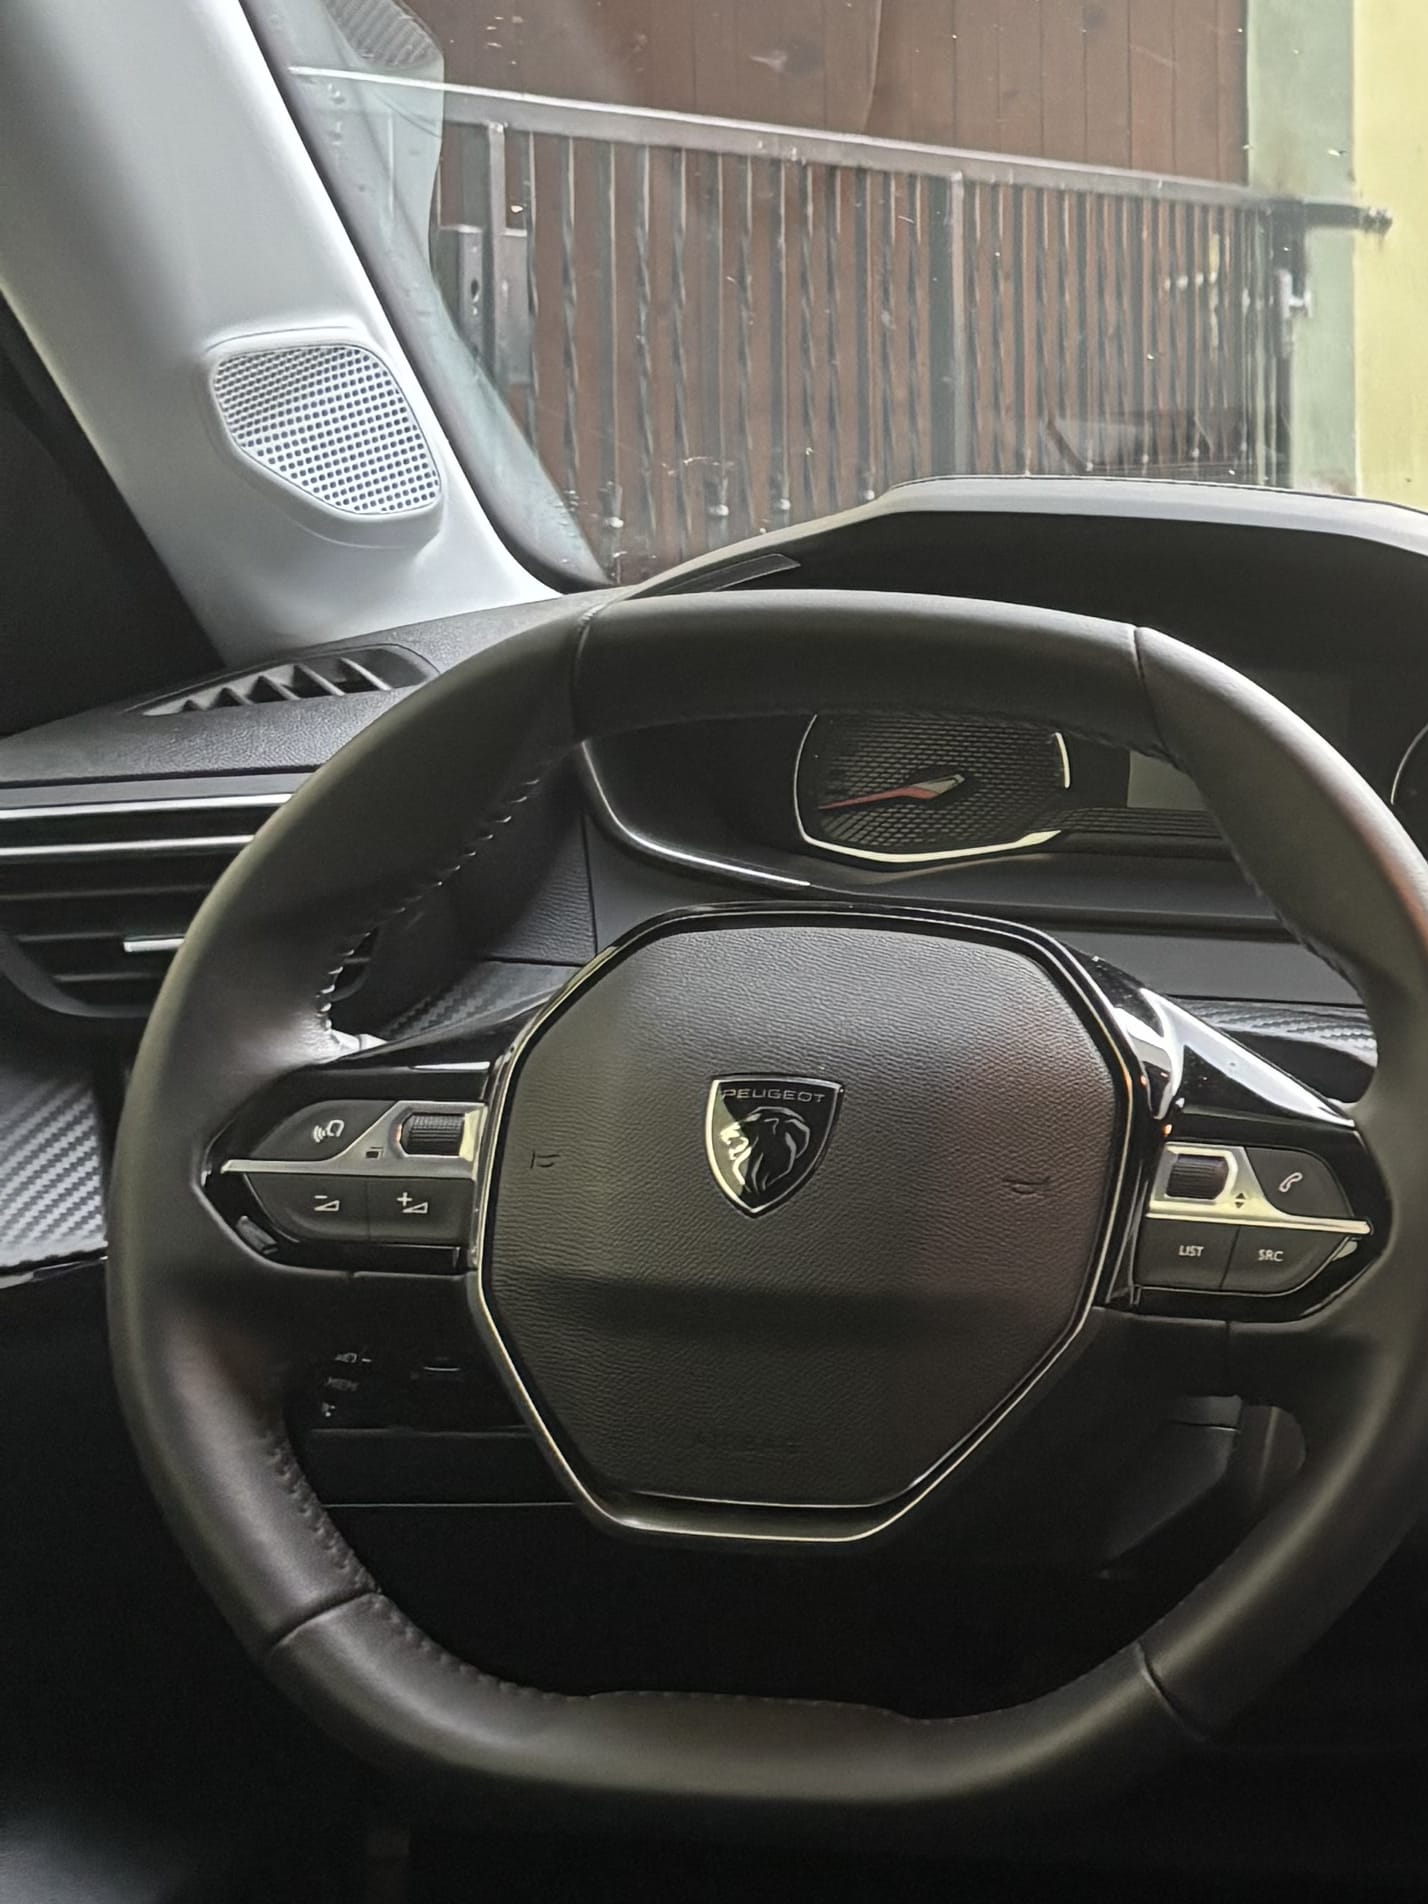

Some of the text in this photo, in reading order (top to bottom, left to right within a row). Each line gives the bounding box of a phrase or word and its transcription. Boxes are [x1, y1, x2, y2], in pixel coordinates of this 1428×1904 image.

[721, 1088, 825, 1103] PEUGEOT
[1178, 1244, 1204, 1257] LIST
[1258, 1248, 1285, 1262] SRC
